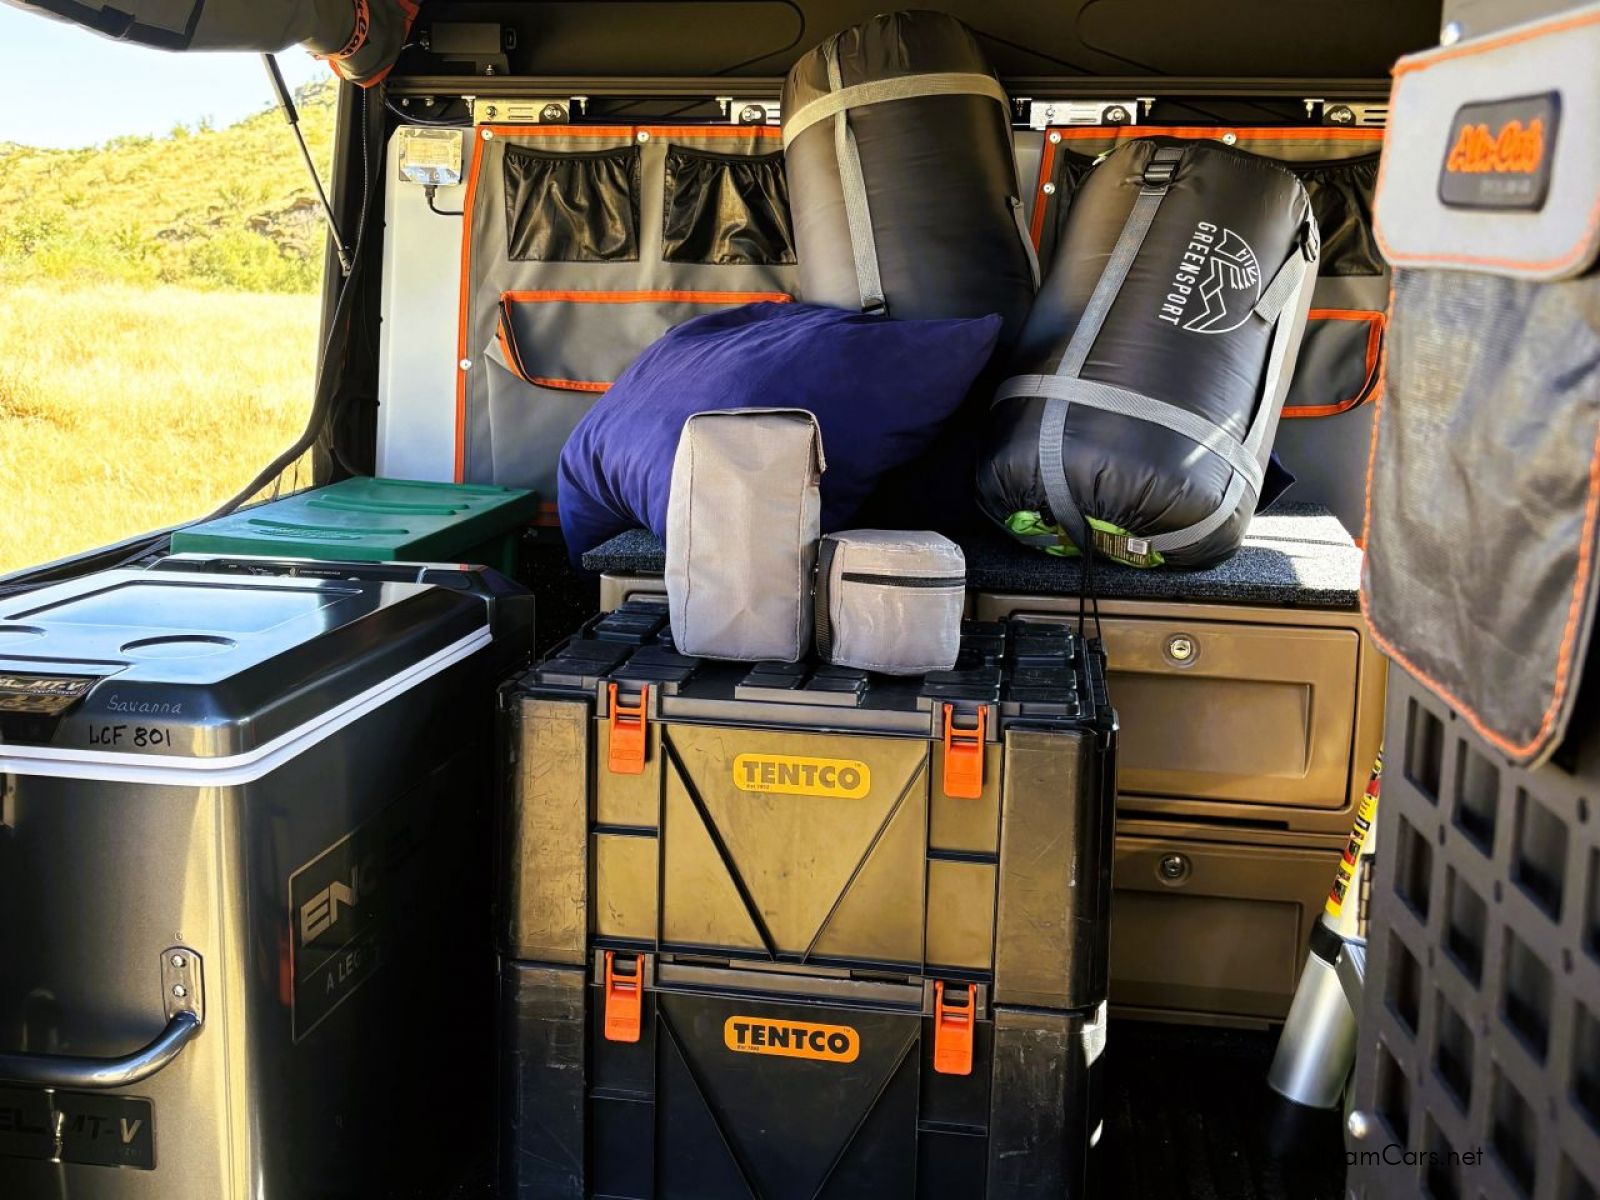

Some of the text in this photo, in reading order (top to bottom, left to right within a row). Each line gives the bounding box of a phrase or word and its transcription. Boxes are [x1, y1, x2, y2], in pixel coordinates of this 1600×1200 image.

[1158, 221, 1218, 326] GREENSPORT
[106, 694, 182, 714] Savanna
[89, 724, 171, 748] LCF 801
[742, 760, 861, 791] TENTCO
[733, 1022, 850, 1054] TENTCO
